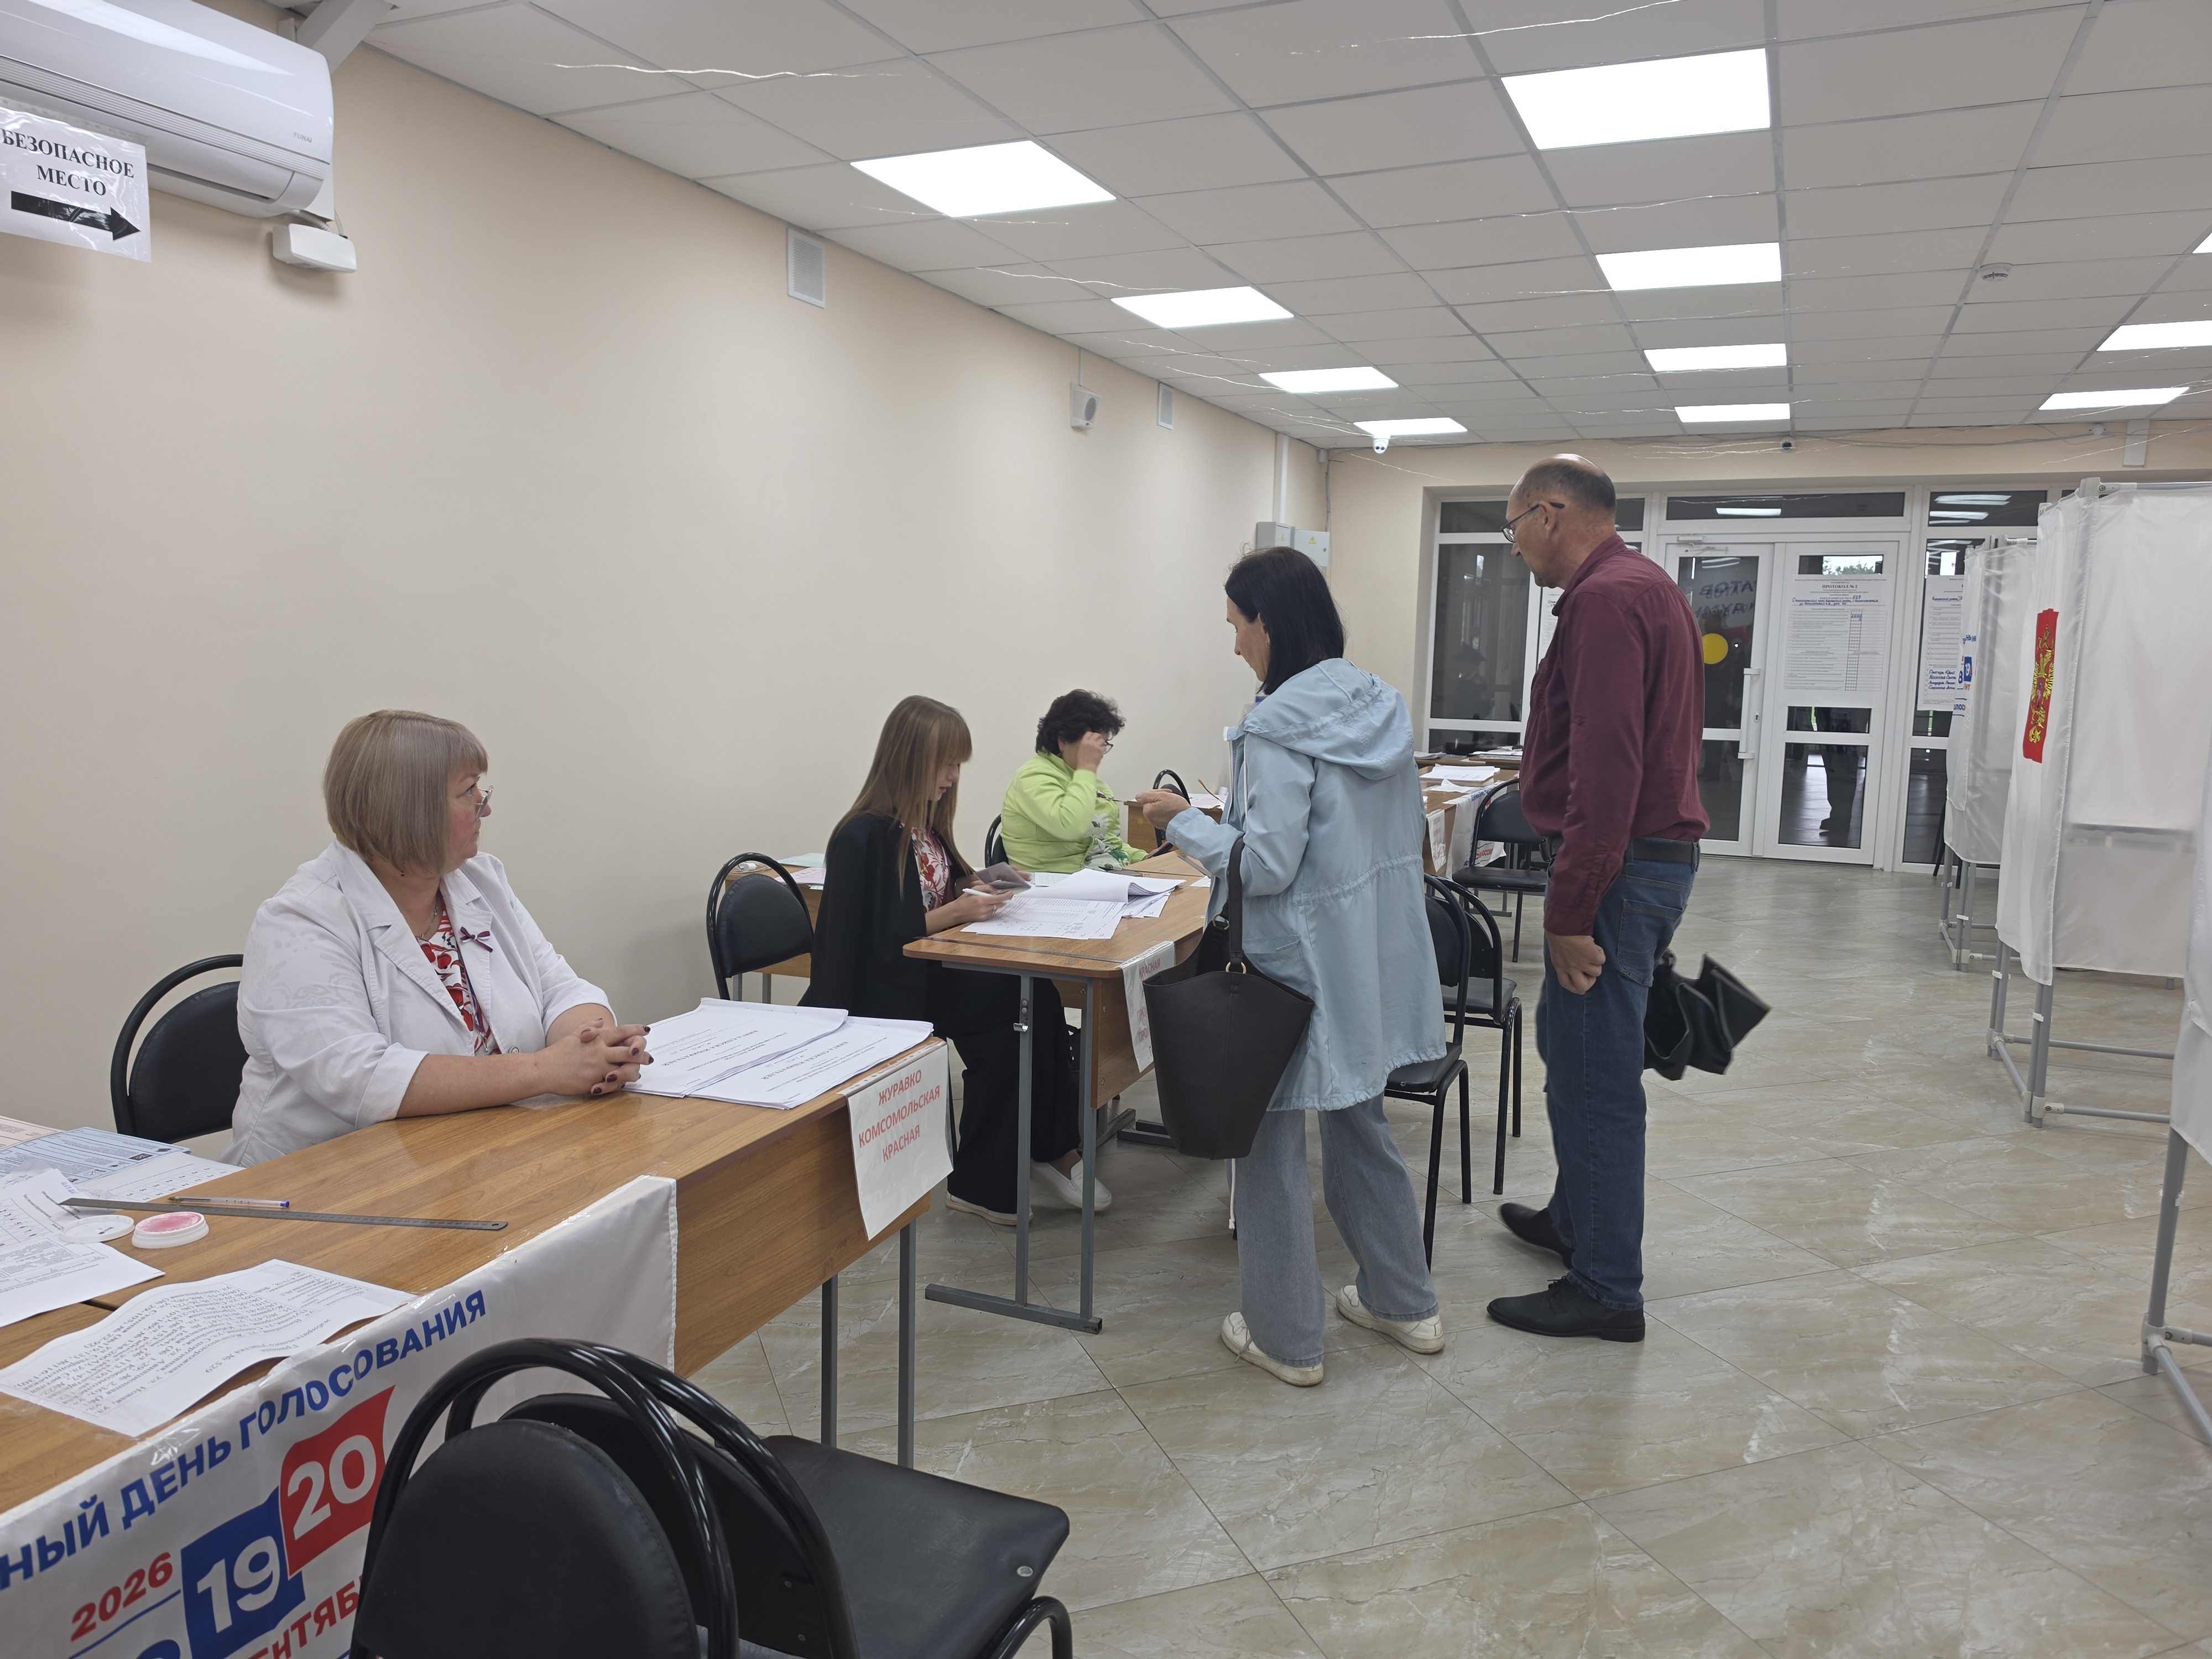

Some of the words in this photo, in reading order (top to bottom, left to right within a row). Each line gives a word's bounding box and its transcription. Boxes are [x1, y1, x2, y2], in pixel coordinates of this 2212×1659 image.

[2, 128, 134, 179] БЕЗОПАСНОЕ
[293, 132, 312, 143] FUNAI
[36, 164, 107, 196] МЕСТО
[1139, 958, 1160, 979] КРАСНАЯ
[878, 1069, 922, 1106] ЖУРАВКО
[859, 1085, 940, 1149] КОМСОМОЛЬСКАЯ
[883, 1124, 920, 1162] КРАСНАЯ
[121, 1310, 157, 1333] Степная
[148, 1325, 186, 1347] Красная
[267, 1319, 331, 1346] избирательного
[163, 1333, 243, 1374] Железнодорожная,
[233, 1343, 266, 1354] участка
[260, 1344, 300, 1352] Границы
[21, 1354, 98, 1390] Ставропольская
[60, 1364, 136, 1404] Комсомольская
[104, 1358, 165, 1395] Авиационная
[205, 1360, 222, 1373] 529
[111, 1386, 147, 1404] Новая,
[0, 1495, 110, 1590] НЫЙ
[121, 1439, 232, 1531] ДЕНЬ
[240, 1290, 486, 1449] ГОЛОСОВАНИЯ
[197, 1535, 281, 1634] 19
[287, 1433, 377, 1541] 20
[70, 1552, 173, 1642] 2026
[248, 1574, 362, 1659] НТЯБ
